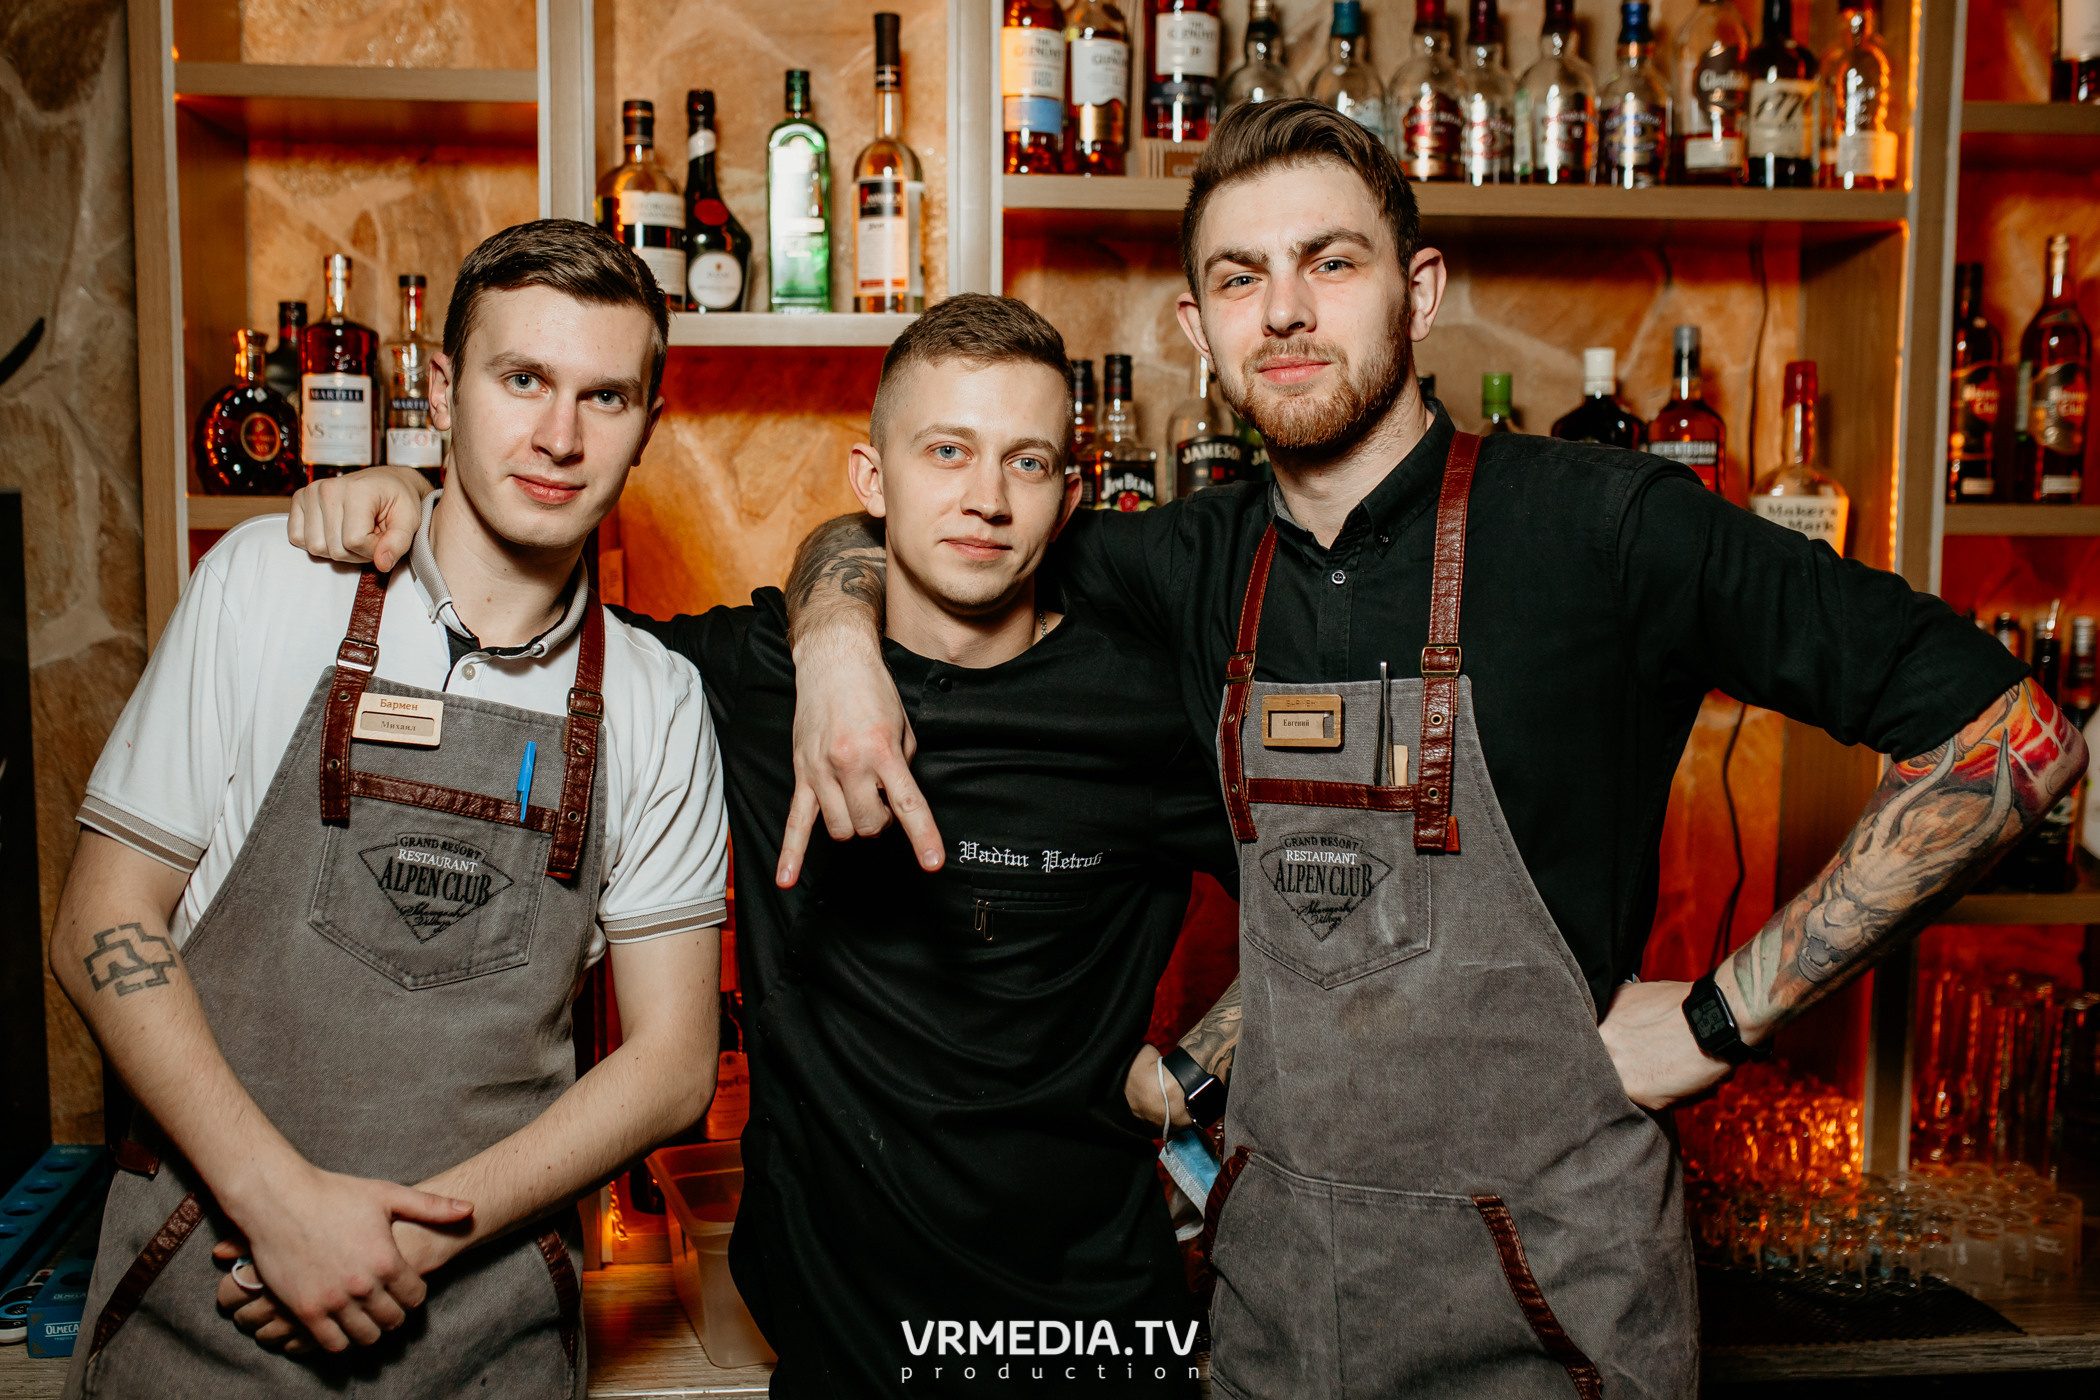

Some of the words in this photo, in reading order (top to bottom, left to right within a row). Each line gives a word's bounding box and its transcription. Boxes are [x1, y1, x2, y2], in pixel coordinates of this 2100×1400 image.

[310, 389, 361, 401] MARTELL
[392, 399, 430, 410] MARTEL
[1182, 442, 1240, 465] JAMESO
[380, 698, 418, 711] Бармен
[381, 720, 417, 732] Михаил
[1283, 718, 1310, 727] Евгений
[400, 836, 439, 849] GRAND
[441, 841, 483, 860] RESORT
[1284, 836, 1318, 848] GRAND
[1320, 836, 1359, 851] RESORT
[397, 848, 479, 873] RESTAURANT
[958, 840, 1030, 868] Vadim
[1286, 849, 1357, 865] RESTAURANT
[379, 856, 444, 899] ALPEN
[442, 871, 492, 907] CLUB
[1274, 858, 1327, 895] ALPEN
[1329, 863, 1373, 898] CLUB
[46, 1323, 80, 1335] OLMECA
